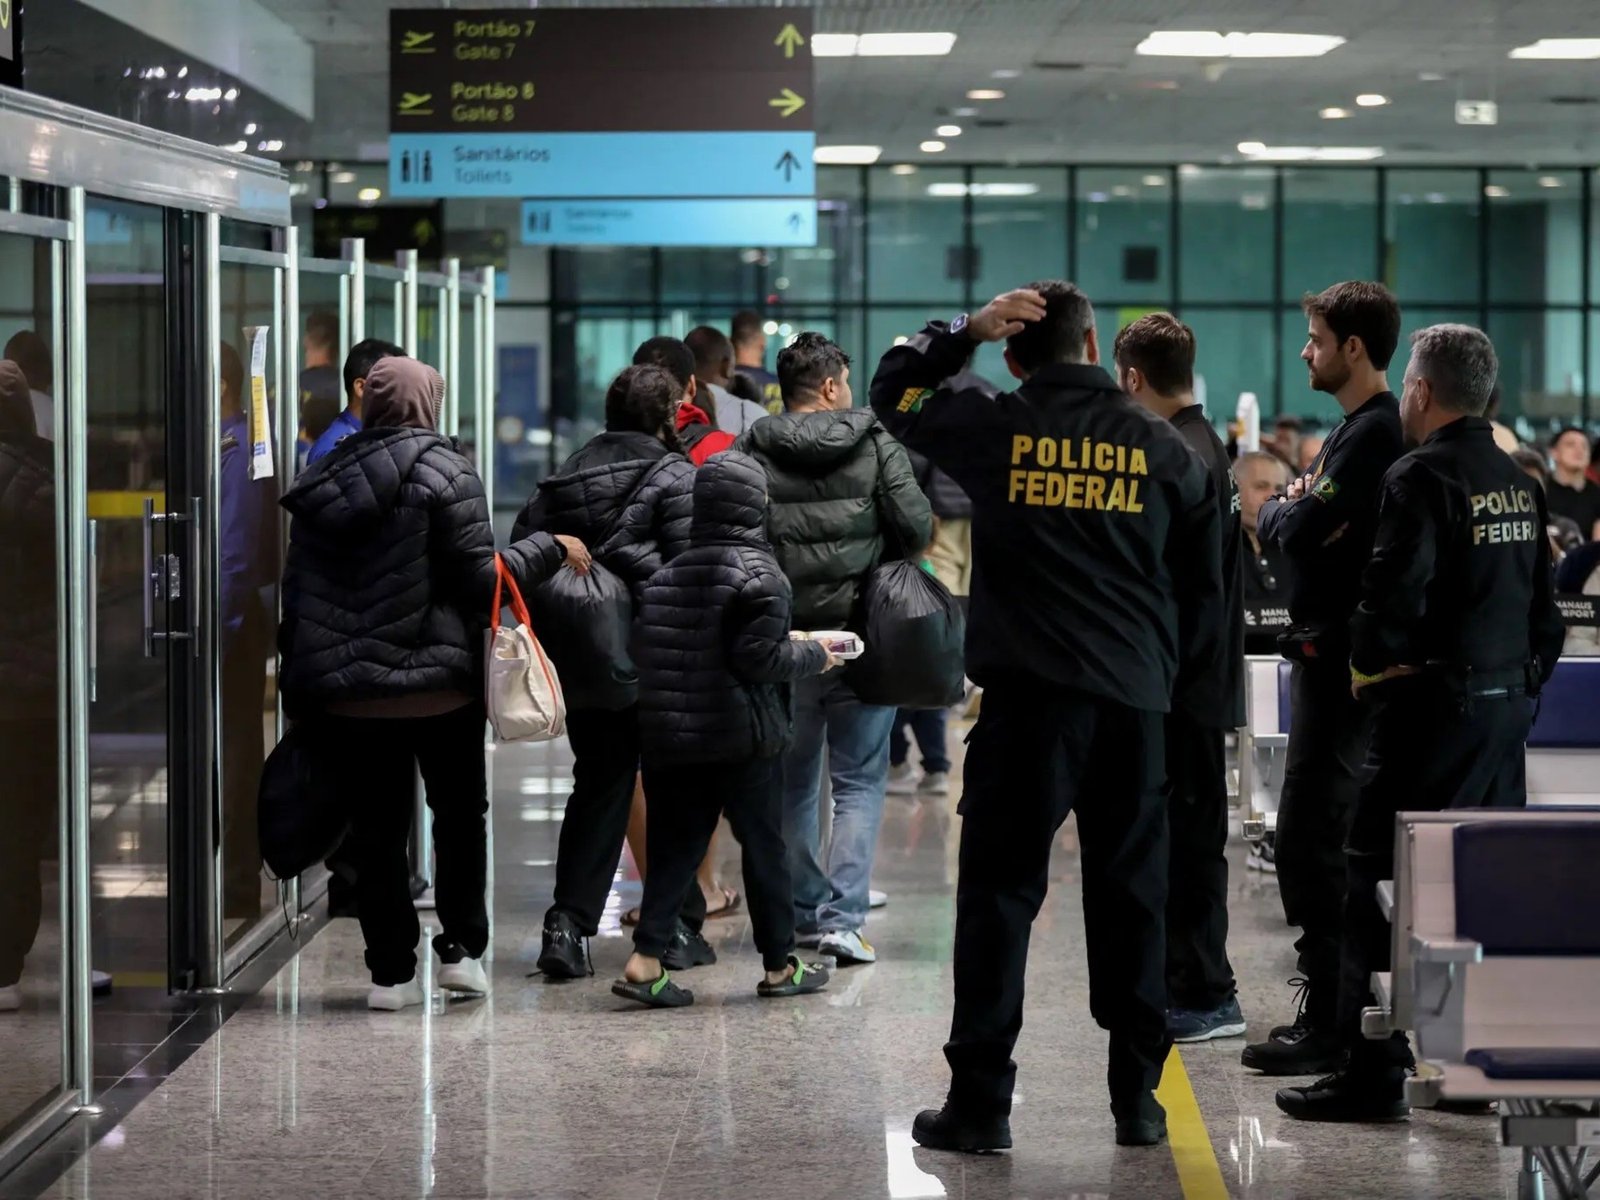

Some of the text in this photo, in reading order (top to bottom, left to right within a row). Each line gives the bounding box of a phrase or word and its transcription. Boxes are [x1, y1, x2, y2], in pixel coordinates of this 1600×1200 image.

[453, 20, 536, 38] Portão 7
[454, 43, 516, 60] Gate 7
[451, 82, 535, 100] Portão 8
[451, 105, 515, 122] Gate 8
[453, 145, 550, 163] Sanitários
[455, 168, 512, 184] Toilets
[1011, 434, 1148, 476] POLÍCIA
[1008, 469, 1144, 513] FEDERAL
